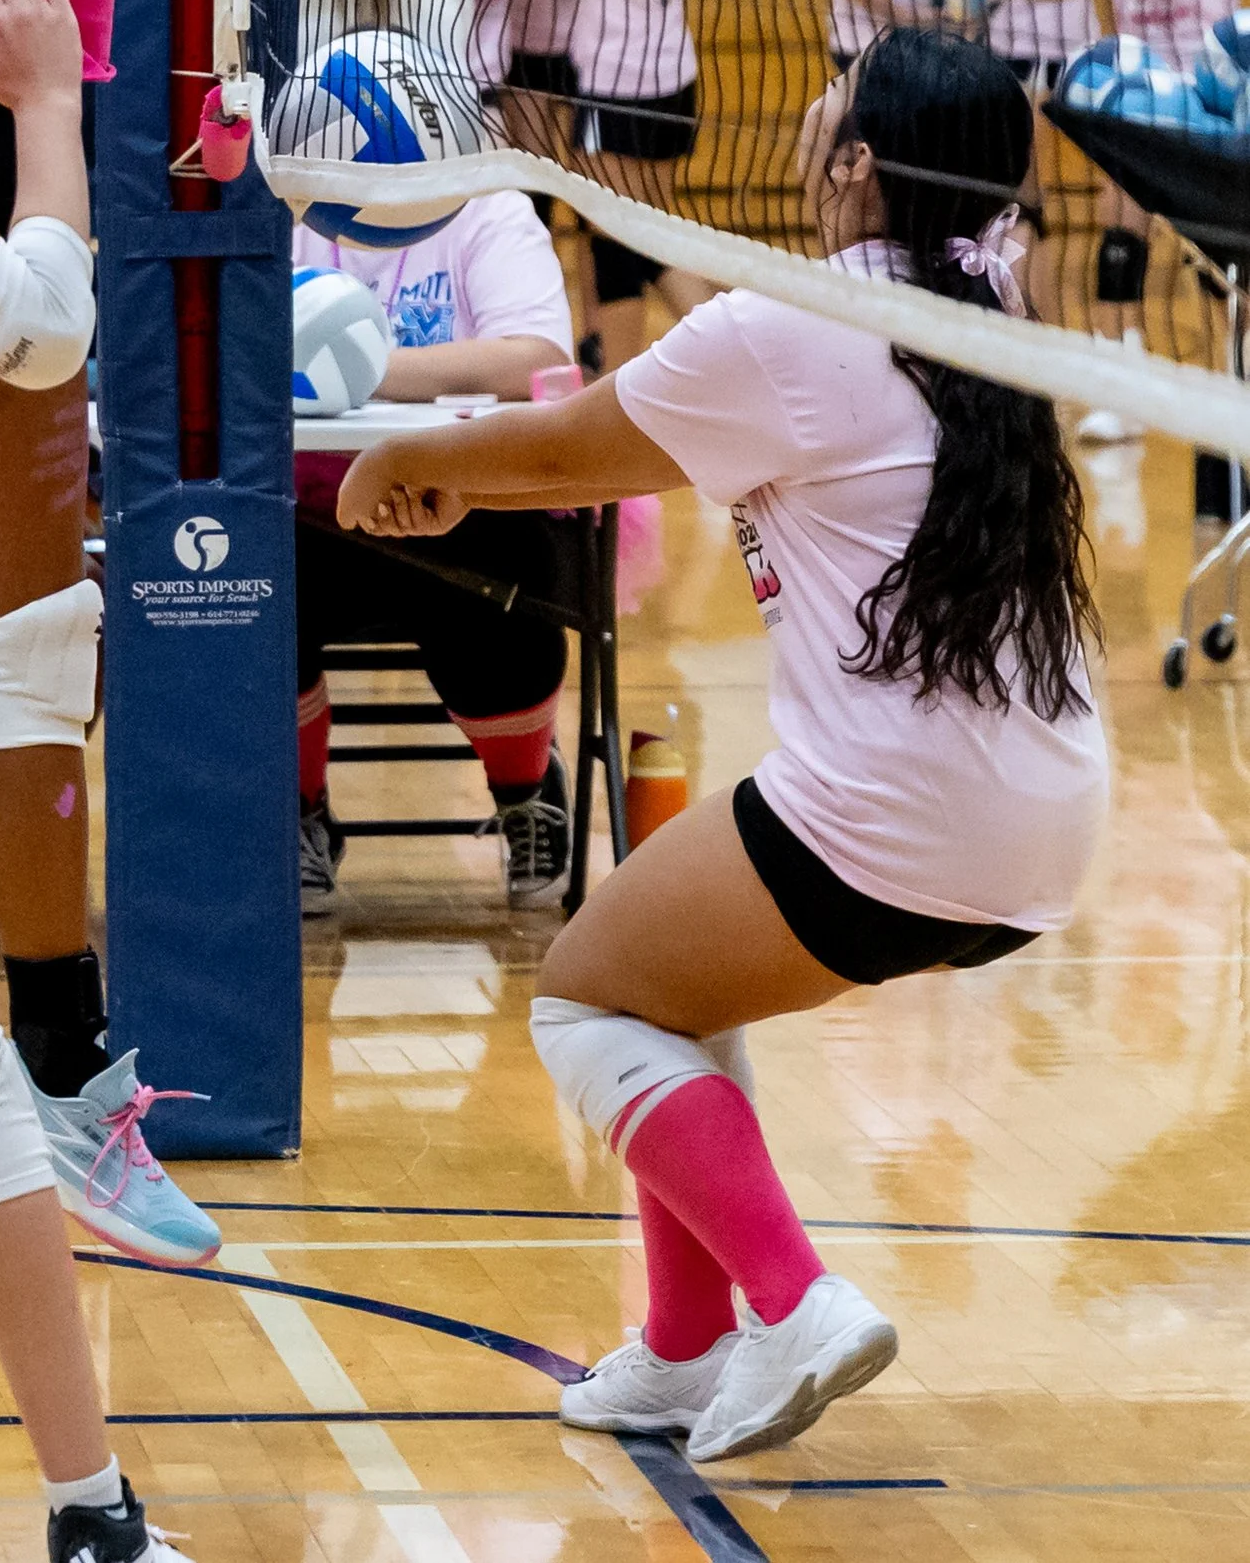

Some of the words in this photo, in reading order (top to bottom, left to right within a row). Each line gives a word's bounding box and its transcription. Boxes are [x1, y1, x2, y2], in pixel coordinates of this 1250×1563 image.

[132, 580, 195, 599] SPORTS
[198, 578, 273, 598] IMPORTS
[144, 595, 170, 606] your
[172, 595, 206, 604] source
[208, 593, 224, 604] for
